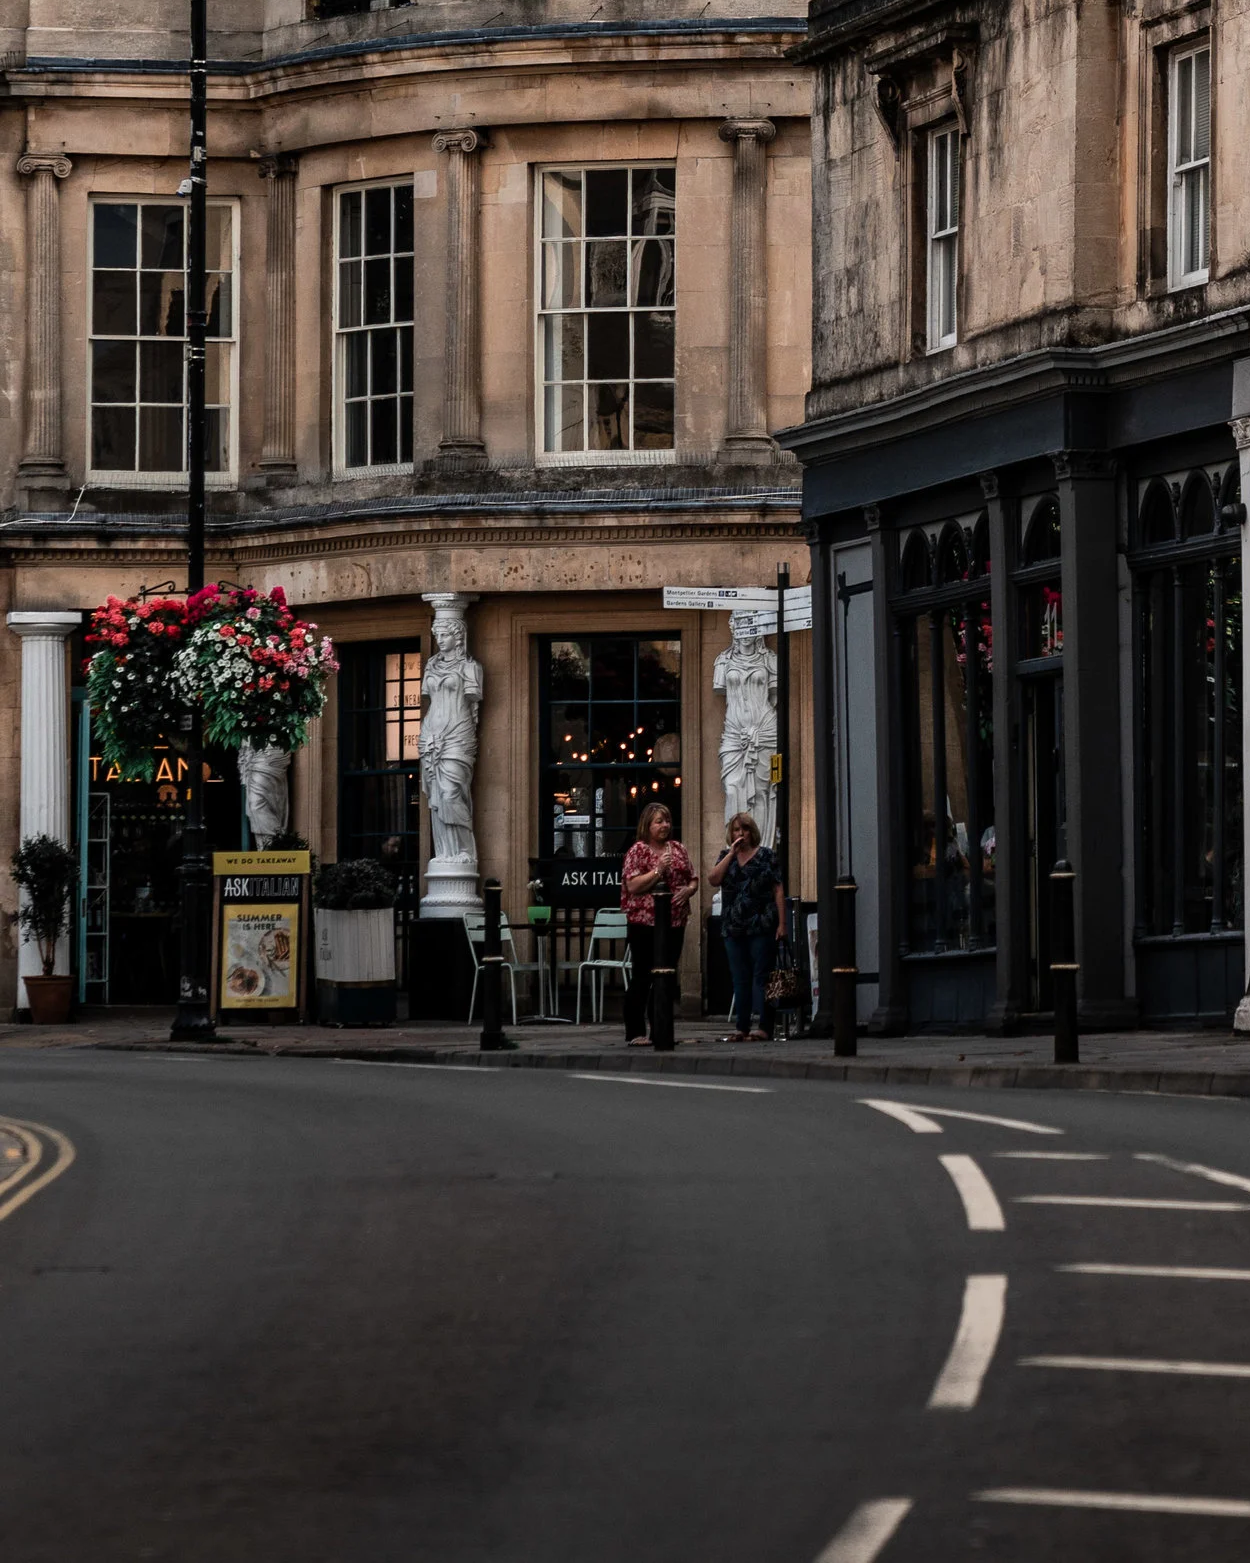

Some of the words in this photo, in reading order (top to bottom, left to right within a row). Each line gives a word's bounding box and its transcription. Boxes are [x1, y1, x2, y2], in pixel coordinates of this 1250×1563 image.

[404, 734, 419, 747] FRES
[771, 757, 779, 780] H
[561, 871, 588, 886] ASK
[592, 871, 622, 886] ITAL
[237, 914, 282, 922] SUMMER
